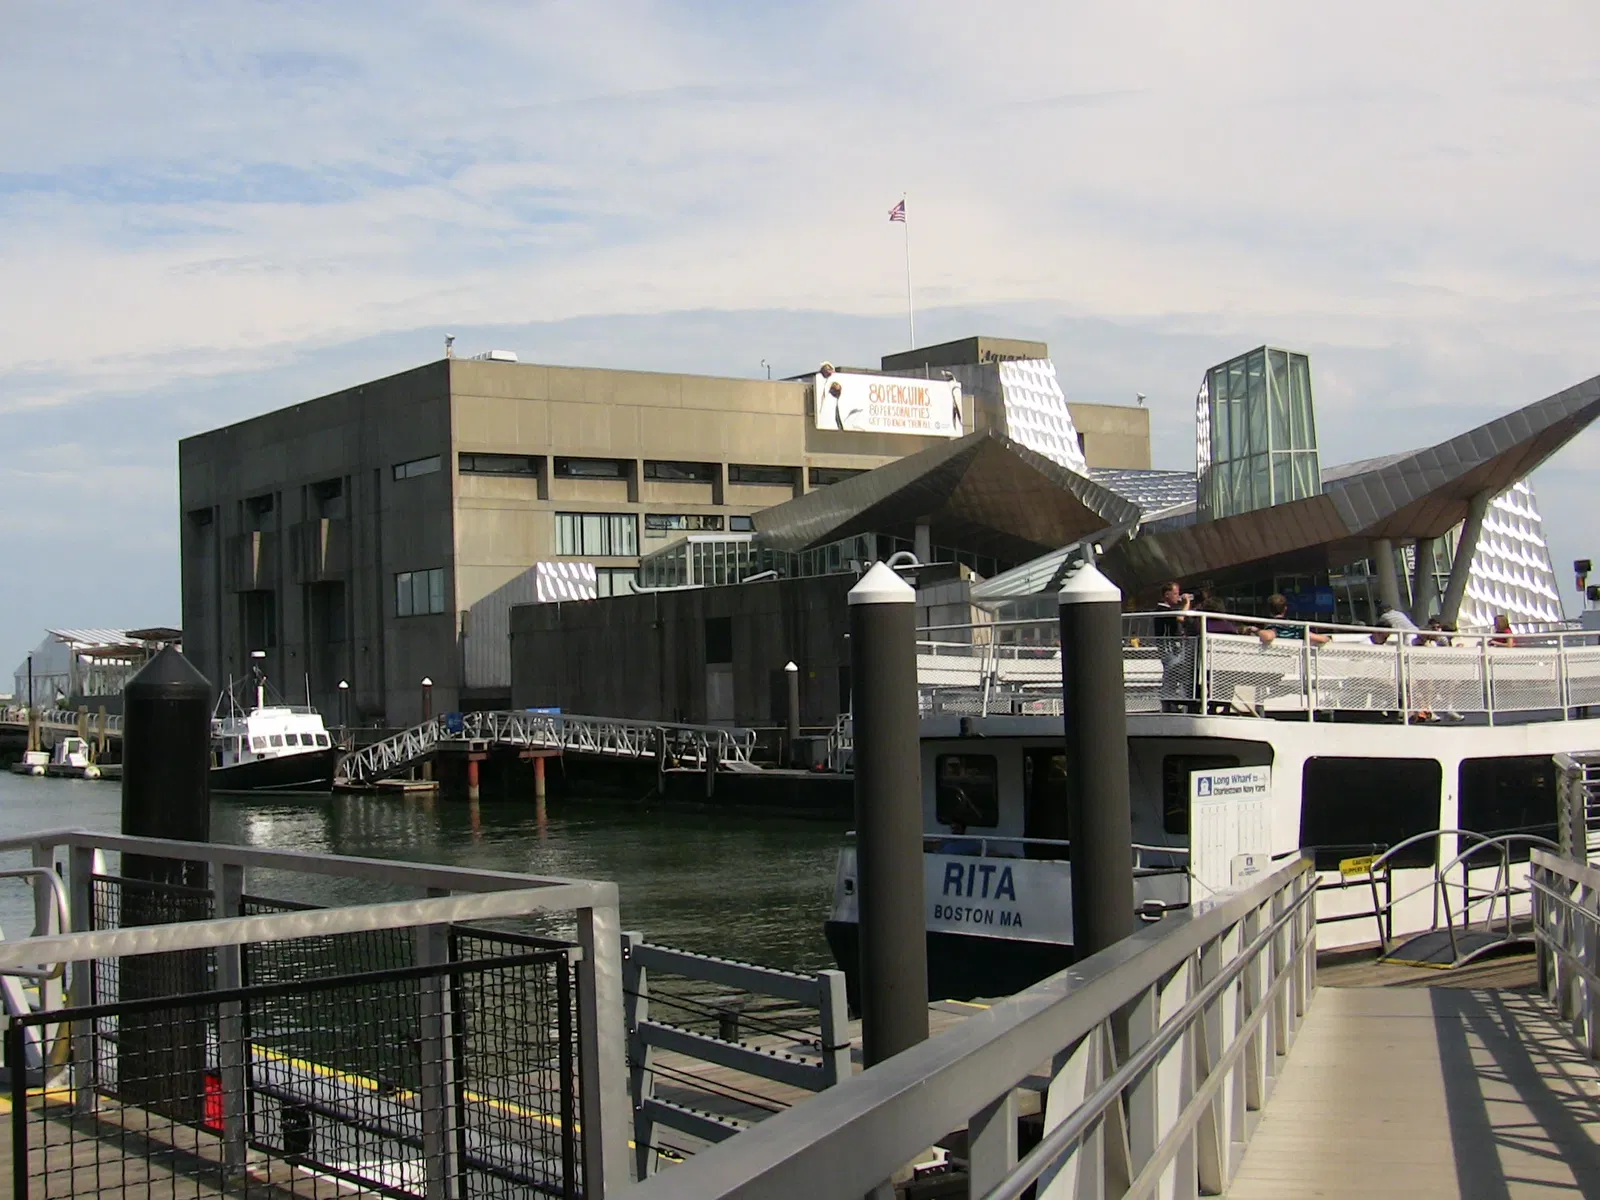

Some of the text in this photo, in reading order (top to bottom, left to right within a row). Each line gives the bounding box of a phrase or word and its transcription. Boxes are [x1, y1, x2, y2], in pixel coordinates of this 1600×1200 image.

[869, 383, 885, 403] 80
[869, 405, 879, 416] 80
[1213, 776, 1230, 785] Long
[1231, 773, 1252, 783] Wharf
[1213, 785, 1266, 796] Charlestown Navy Yard
[943, 862, 1016, 901] RITA
[934, 904, 1023, 928] BOSTON MA
